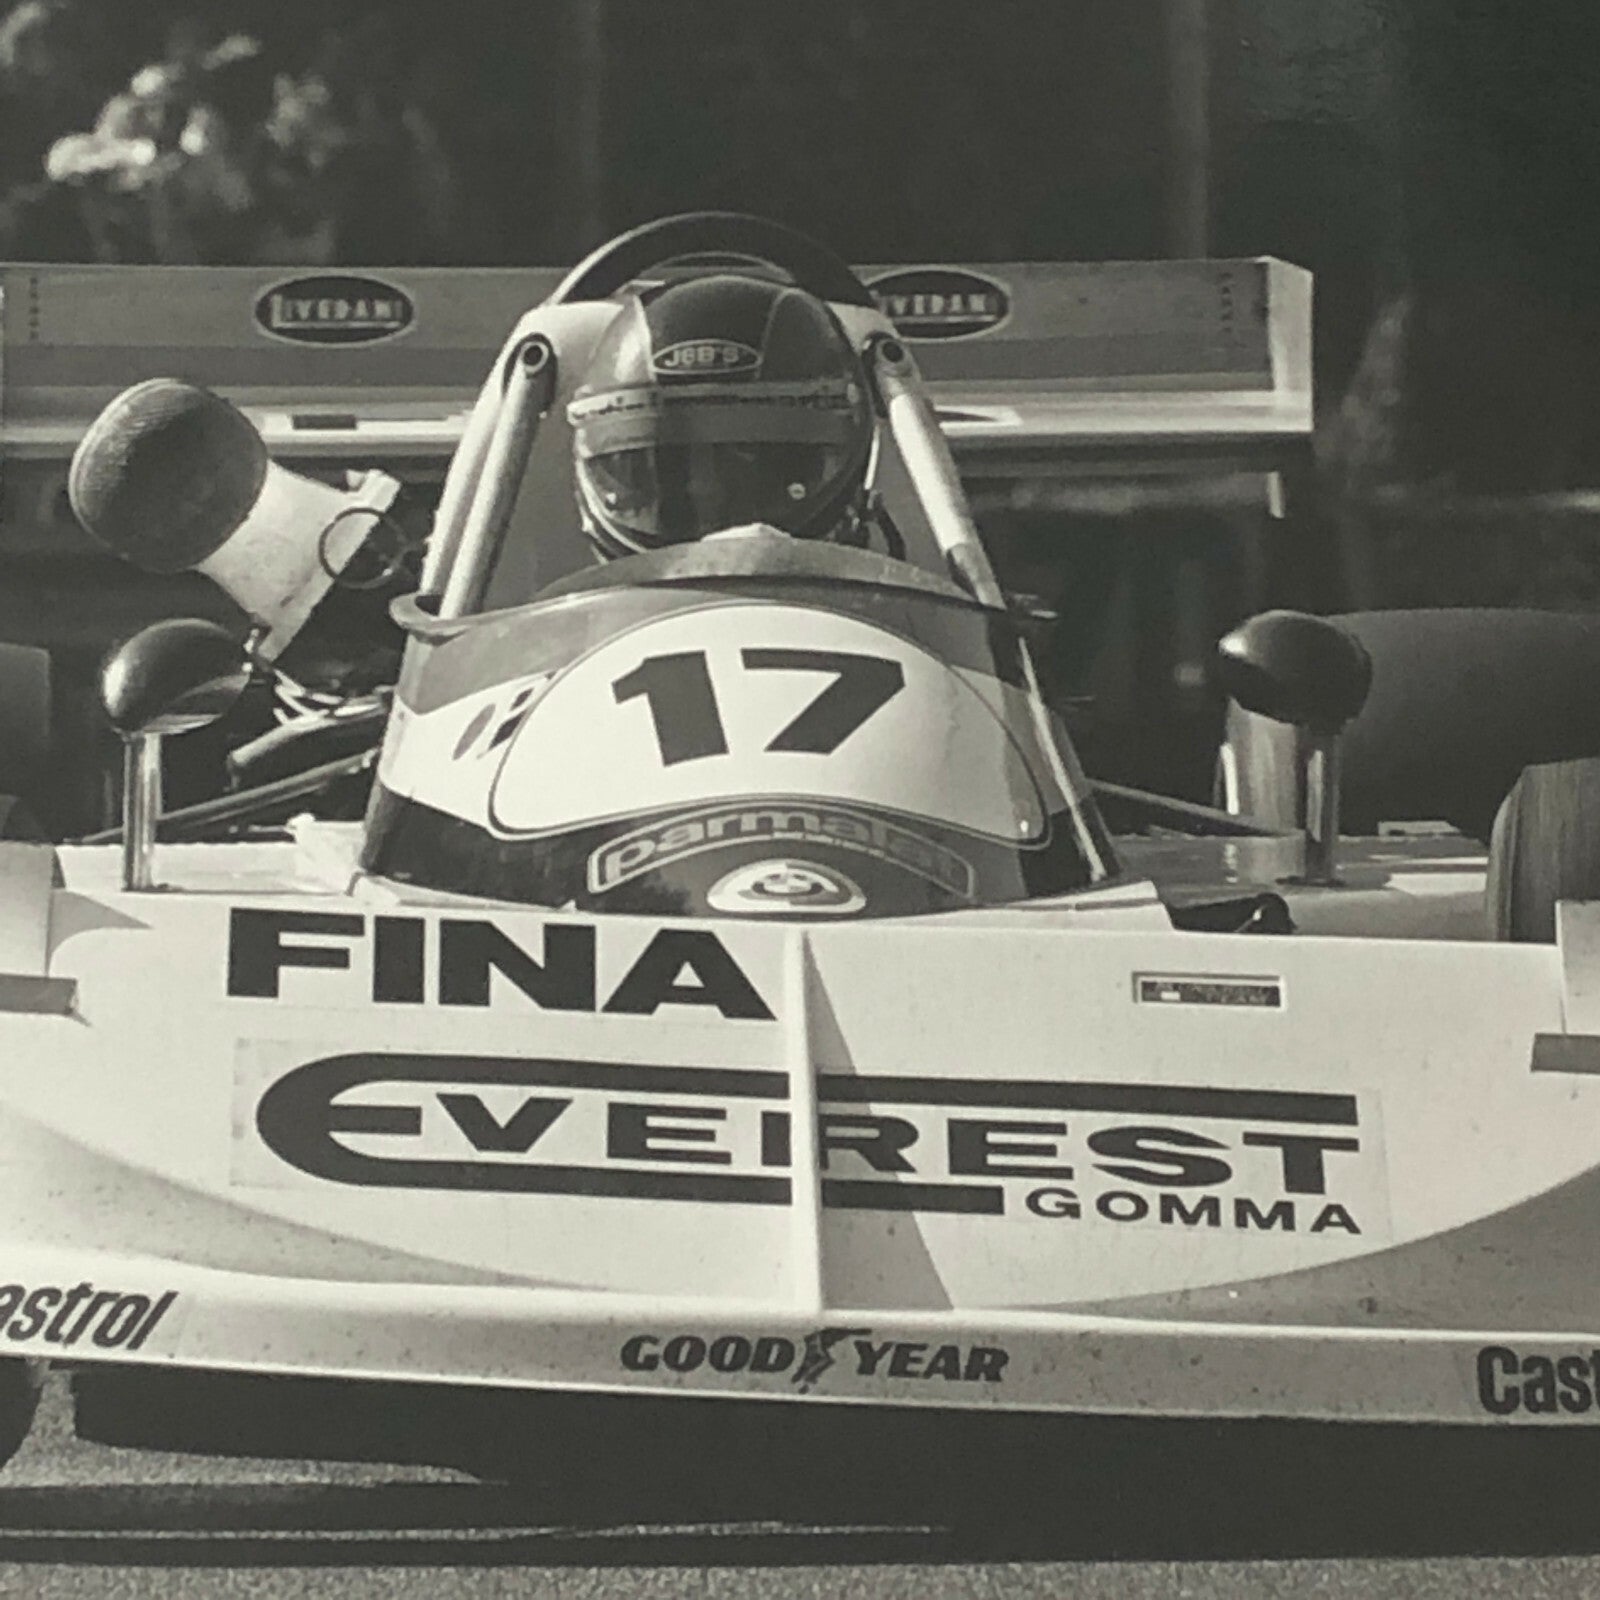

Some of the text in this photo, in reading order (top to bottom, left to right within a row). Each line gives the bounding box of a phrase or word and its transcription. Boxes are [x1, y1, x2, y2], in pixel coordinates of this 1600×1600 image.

[611, 648, 906, 767] 17
[227, 907, 777, 1021] FINA
[256, 1052, 1360, 1215] EVEREST
[1025, 1187, 1361, 1234] GOMMA
[620, 1335, 1009, 1382] GOOD YEAR
